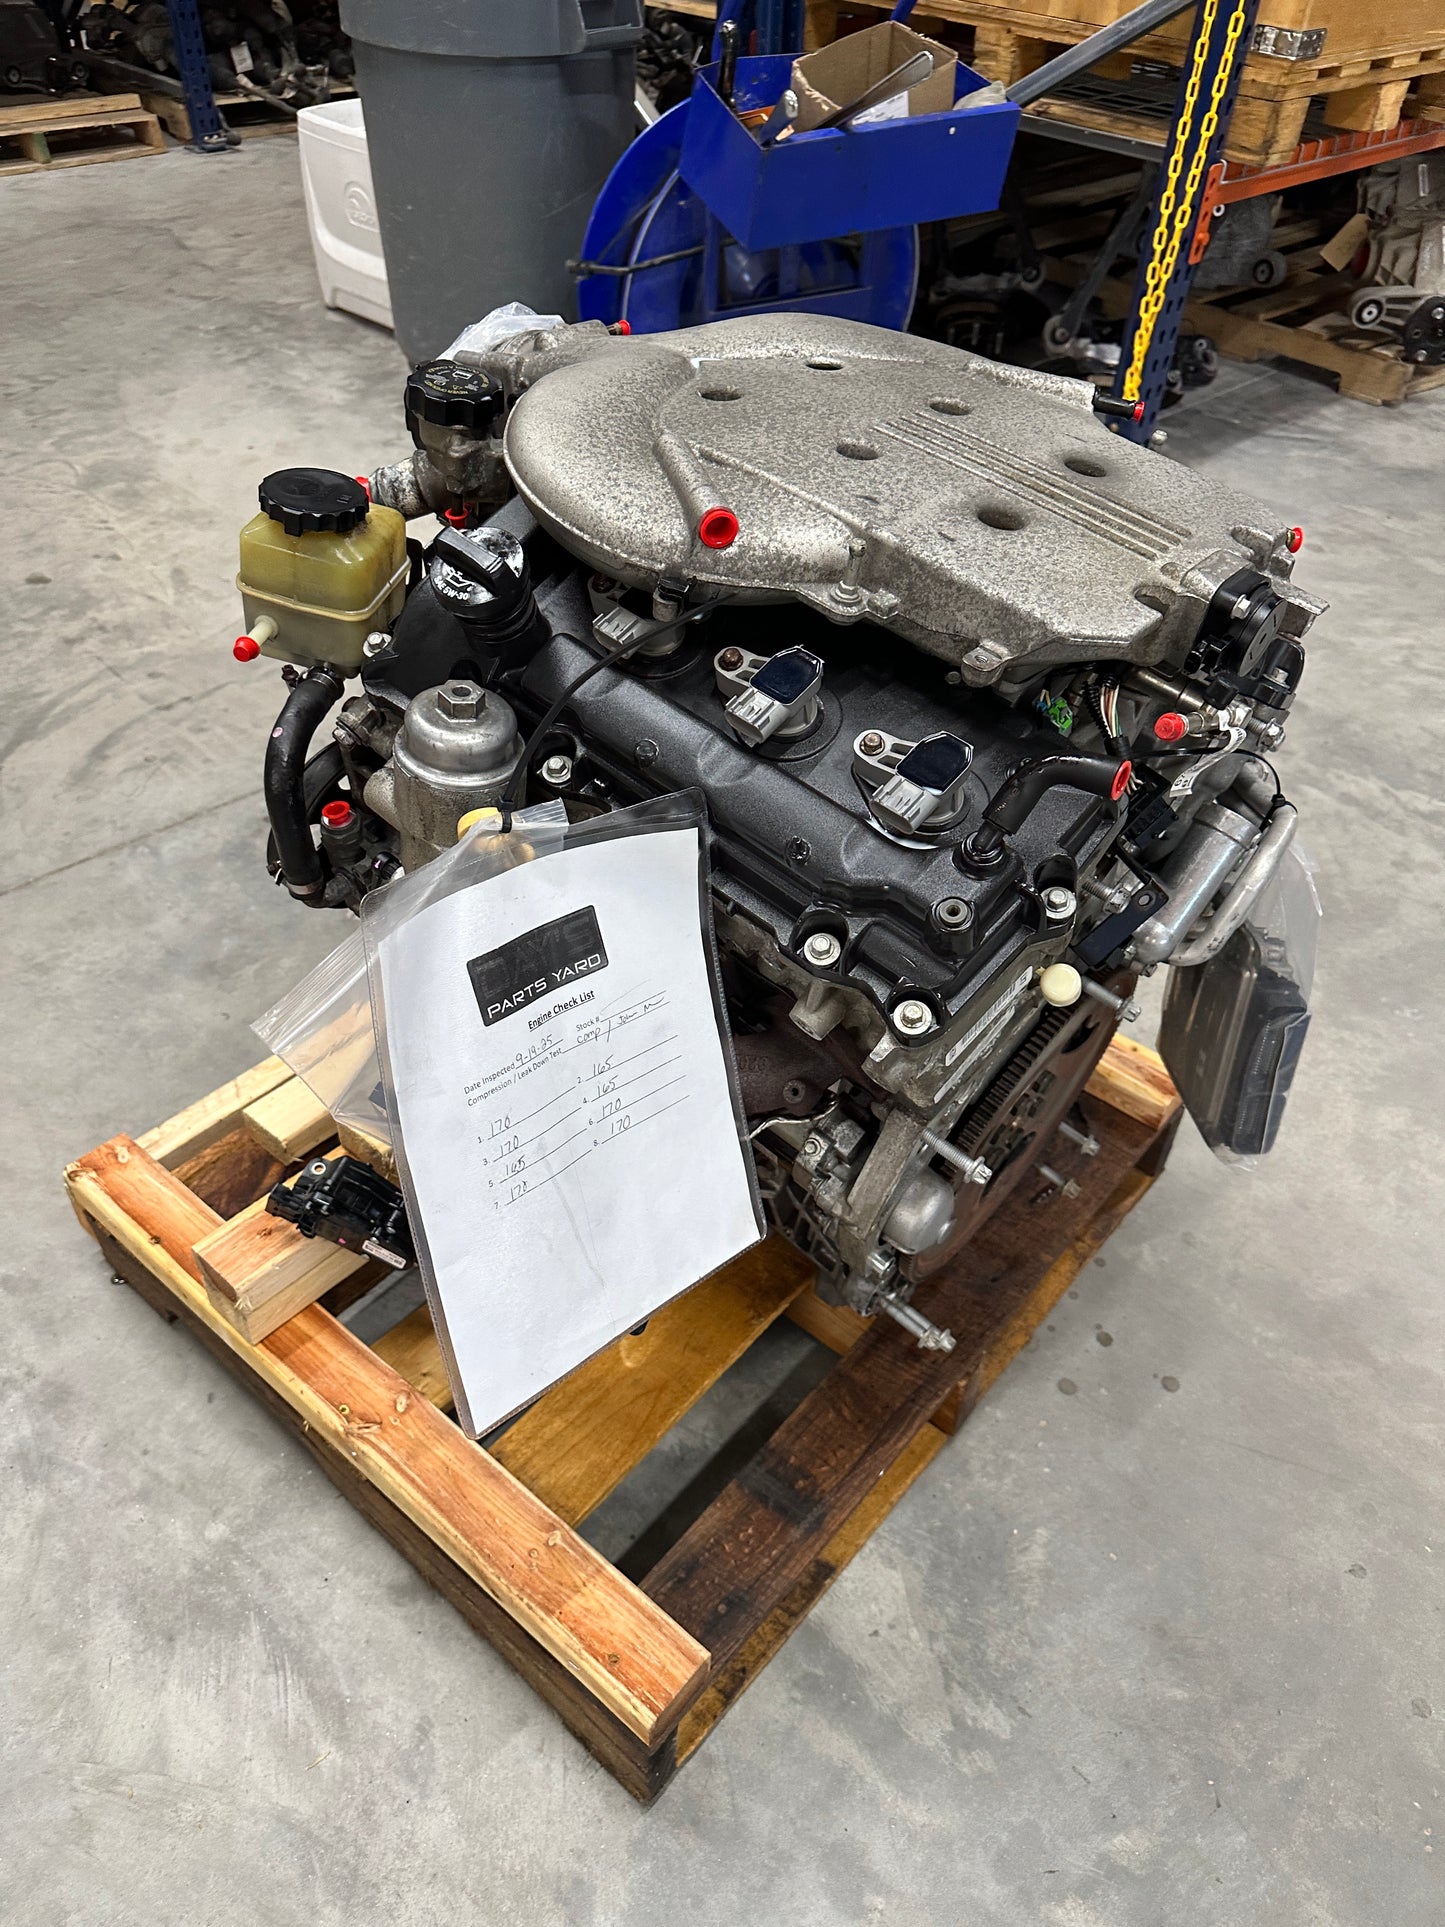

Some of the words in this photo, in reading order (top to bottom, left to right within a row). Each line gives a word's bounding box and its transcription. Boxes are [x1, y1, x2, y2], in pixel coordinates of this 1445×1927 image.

[443, 586, 469, 600] 5W-30
[487, 977, 547, 1019] PARTS
[552, 953, 601, 982] YARD
[528, 1010, 552, 1030] Engine
[553, 997, 579, 1014] Check
[579, 990, 595, 1004] List
[576, 1018, 594, 1032] Stock
[593, 1054, 614, 1077] 165
[464, 1081, 481, 1095] Date
[482, 1062, 516, 1086] Inspected
[467, 1079, 513, 1107] Compression
[517, 1067, 532, 1080] Leak
[532, 1056, 549, 1071] Down
[549, 1048, 562, 1059] Test
[597, 1074, 619, 1098] 165
[602, 1098, 622, 1118] 170
[611, 1114, 631, 1134] 170
[500, 1135, 519, 1157] 170
